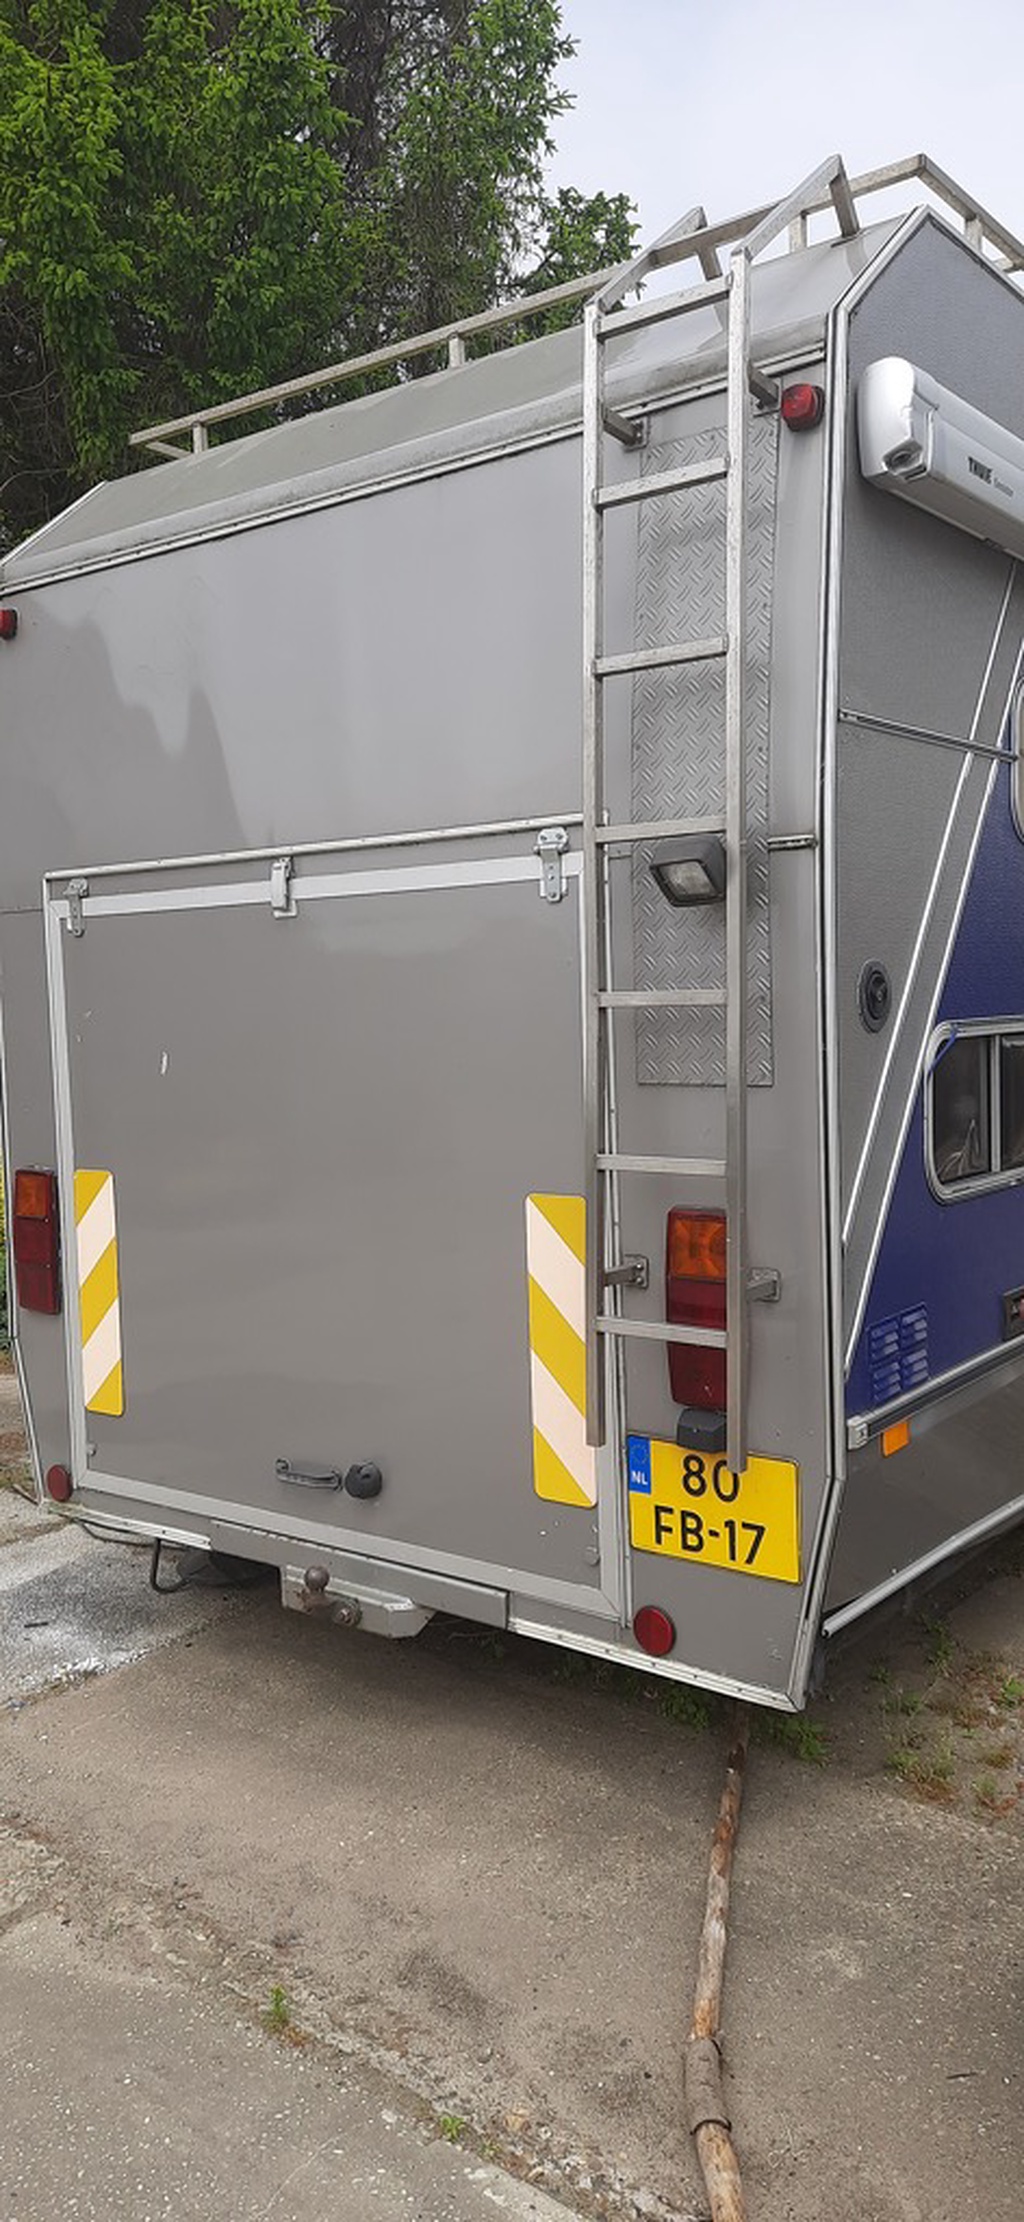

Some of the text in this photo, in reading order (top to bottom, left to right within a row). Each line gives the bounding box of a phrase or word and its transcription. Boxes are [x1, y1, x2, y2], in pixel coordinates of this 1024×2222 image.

[631, 1470, 648, 1486] NL
[682, 1453, 740, 1503] 80
[654, 1504, 766, 1565] FB-17
